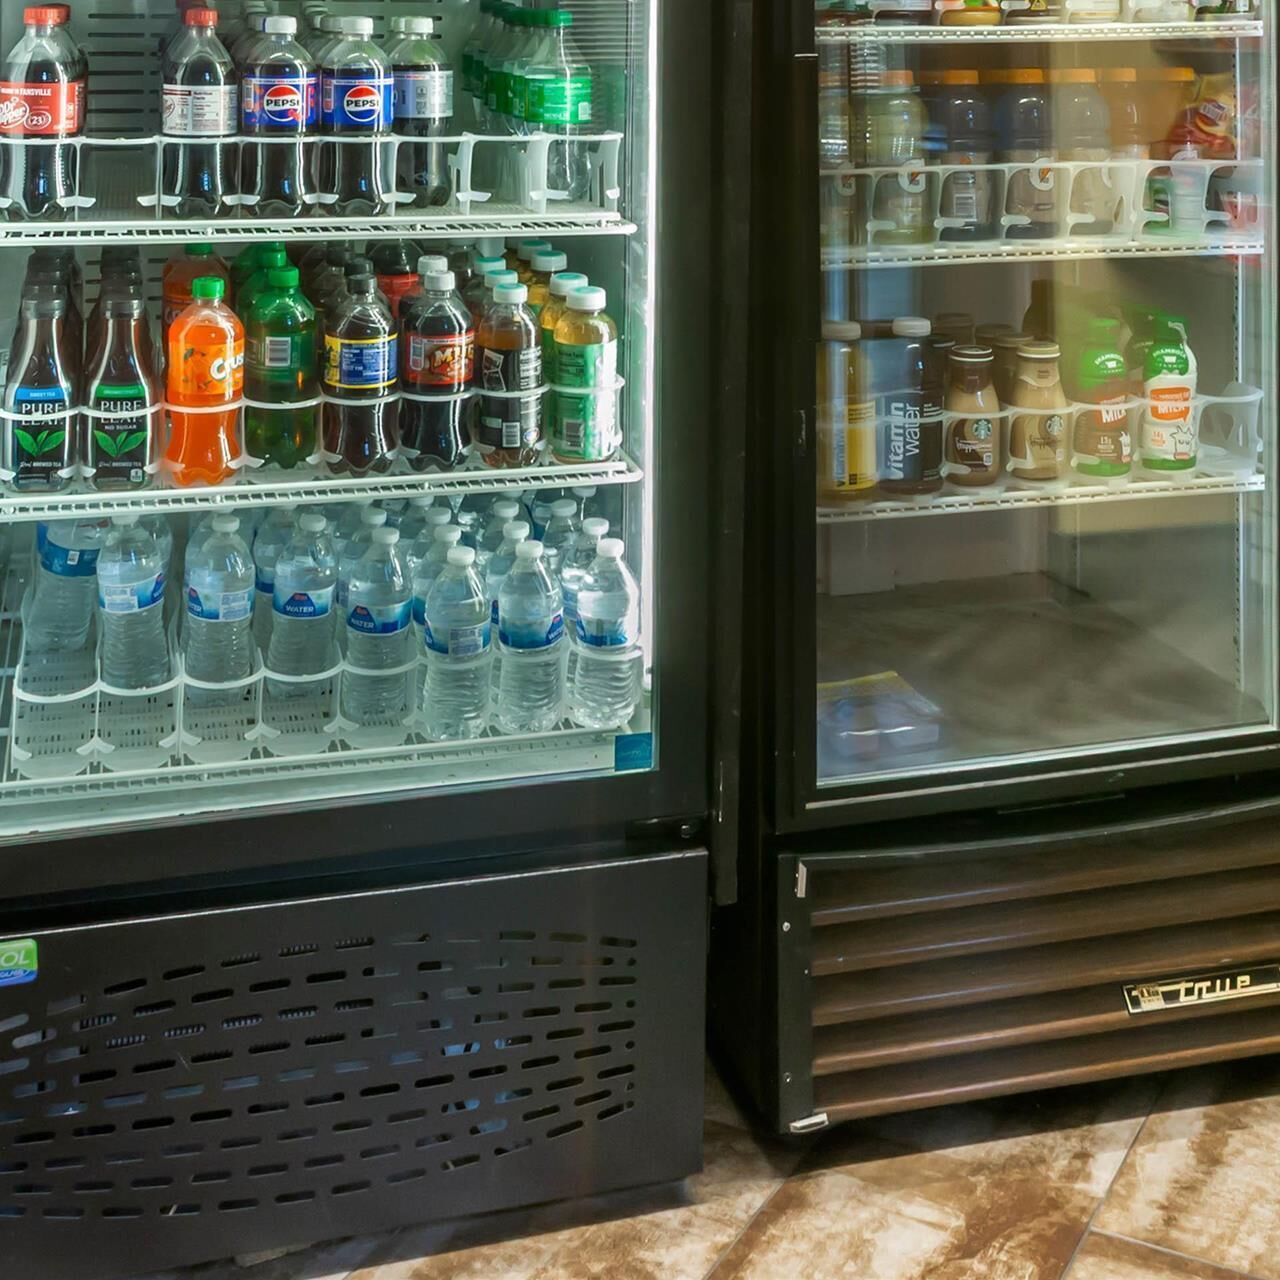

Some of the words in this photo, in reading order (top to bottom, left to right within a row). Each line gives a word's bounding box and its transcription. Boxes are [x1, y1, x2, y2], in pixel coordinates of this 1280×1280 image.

[265, 97, 301, 108] PEPSI
[346, 97, 381, 108] PEPSI
[31, 115, 42, 125] 23
[210, 353, 244, 381] Crus
[21, 400, 64, 414] PURE
[100, 400, 142, 413] PURE
[905, 403, 920, 456] water
[285, 604, 315, 614] WATER
[350, 618, 374, 629] WATER
